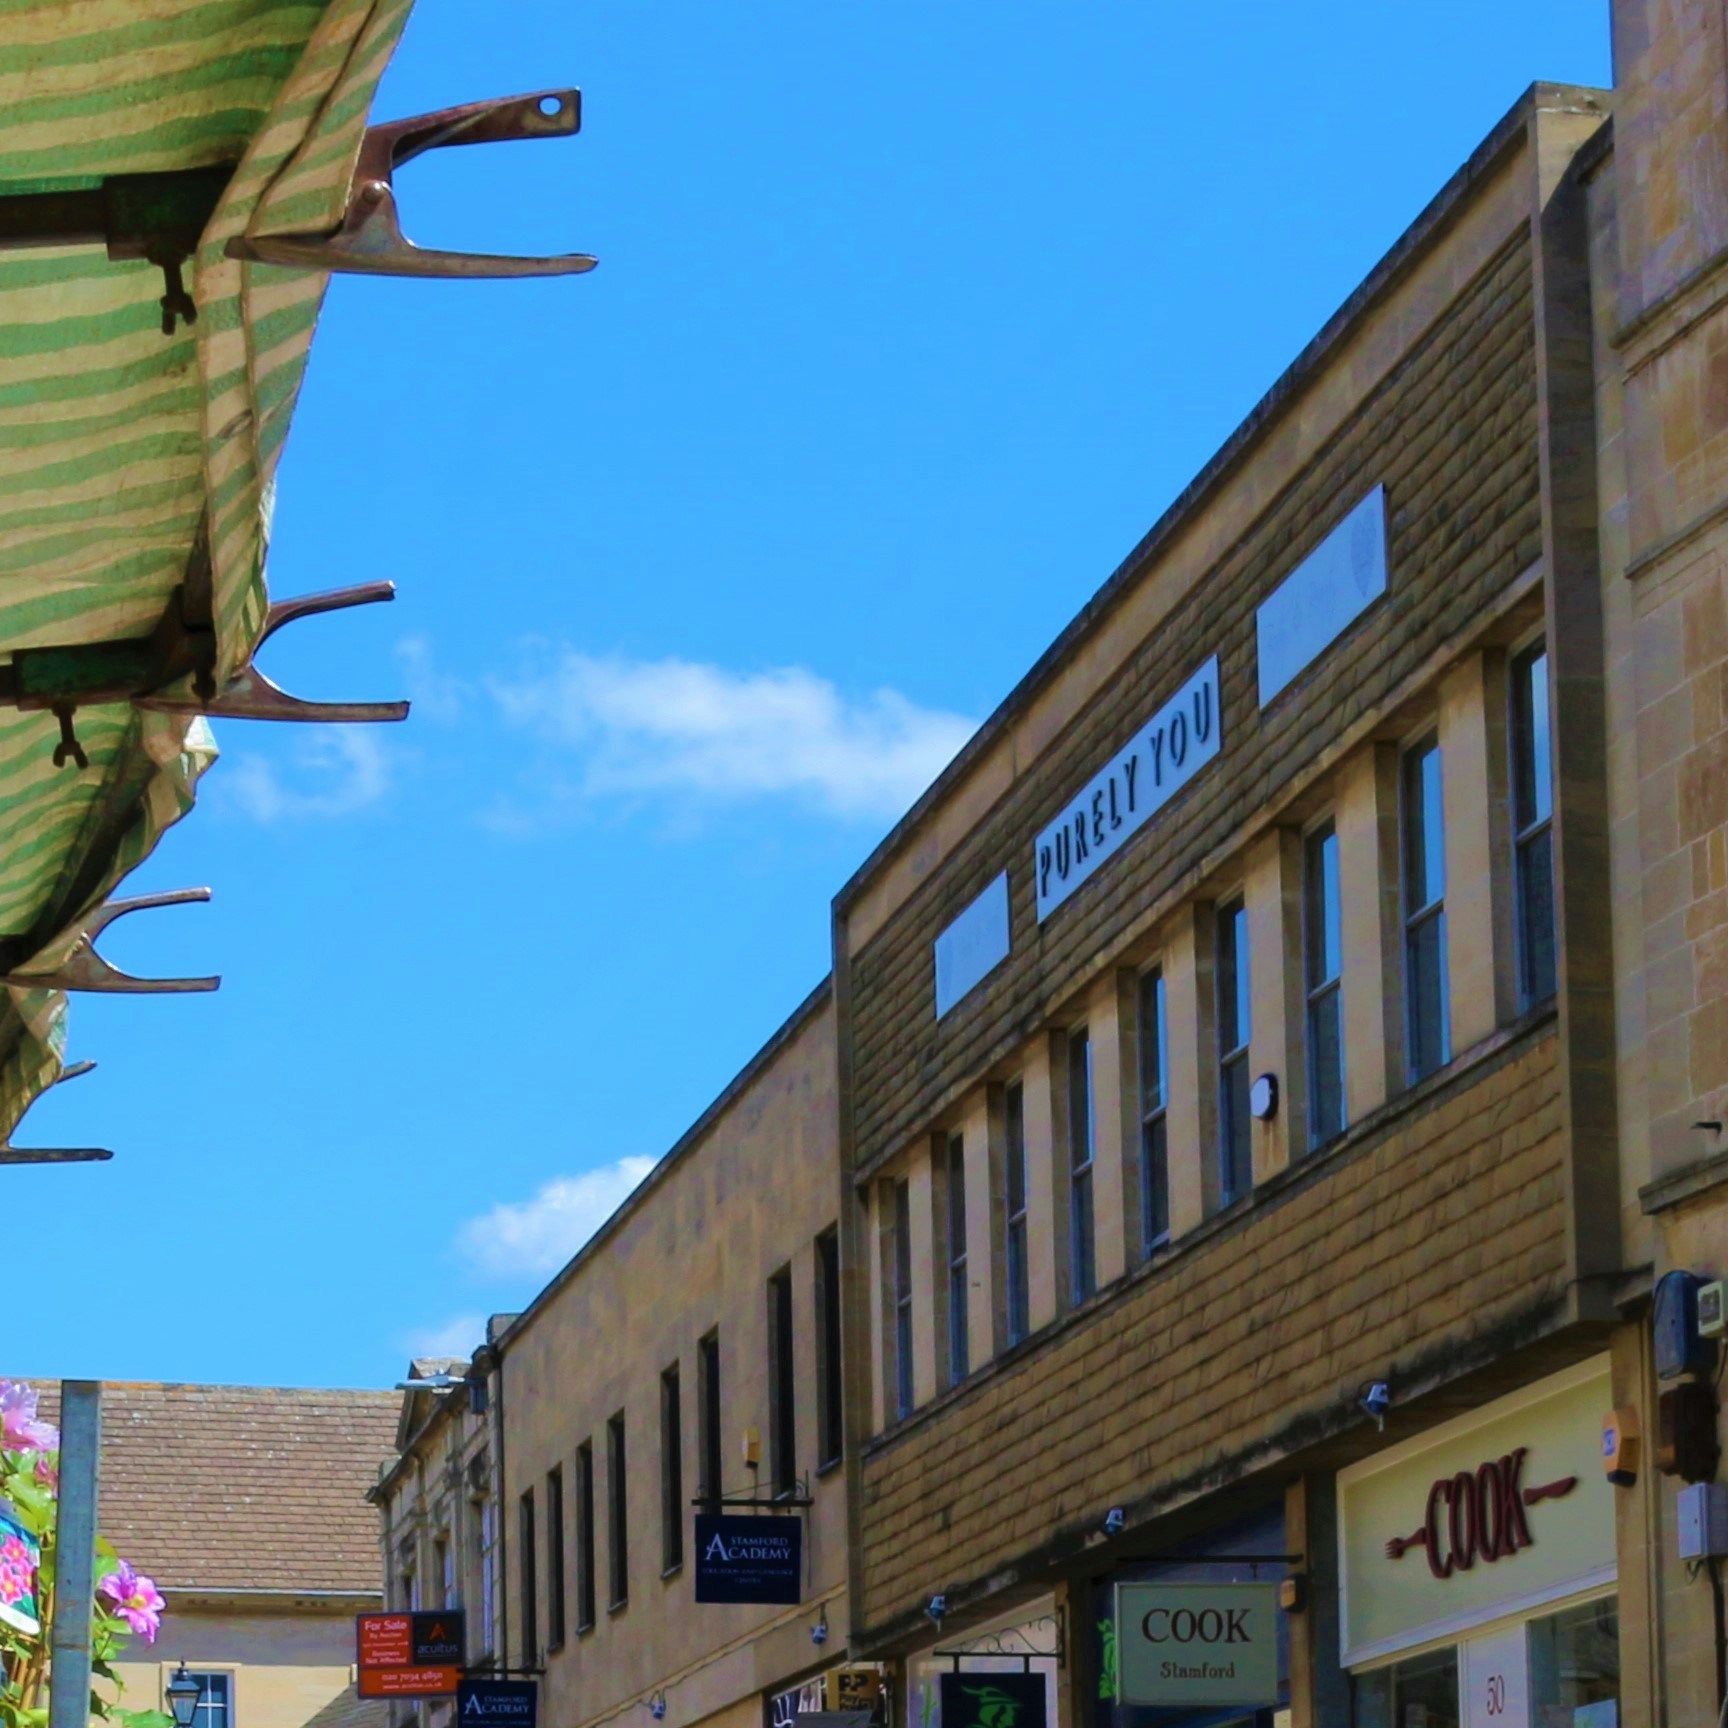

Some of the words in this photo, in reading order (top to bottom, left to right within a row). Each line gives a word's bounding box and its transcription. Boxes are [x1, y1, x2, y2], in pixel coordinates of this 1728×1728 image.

[1040, 754, 1137, 898] PURELY
[1150, 681, 1209, 787] YOU
[1425, 1446, 1534, 1579] COOK
[704, 1532, 792, 1560] ACADEMY
[731, 1536, 789, 1546] STAMFORD
[364, 1621, 381, 1631] For
[384, 1620, 407, 1630] Sale
[1142, 1608, 1252, 1643] COOK
[417, 1642, 459, 1654] acuitus
[1160, 1661, 1235, 1680] Stamford
[464, 1693, 529, 1714] ACADEMY
[1486, 1675, 1505, 1716] 50
